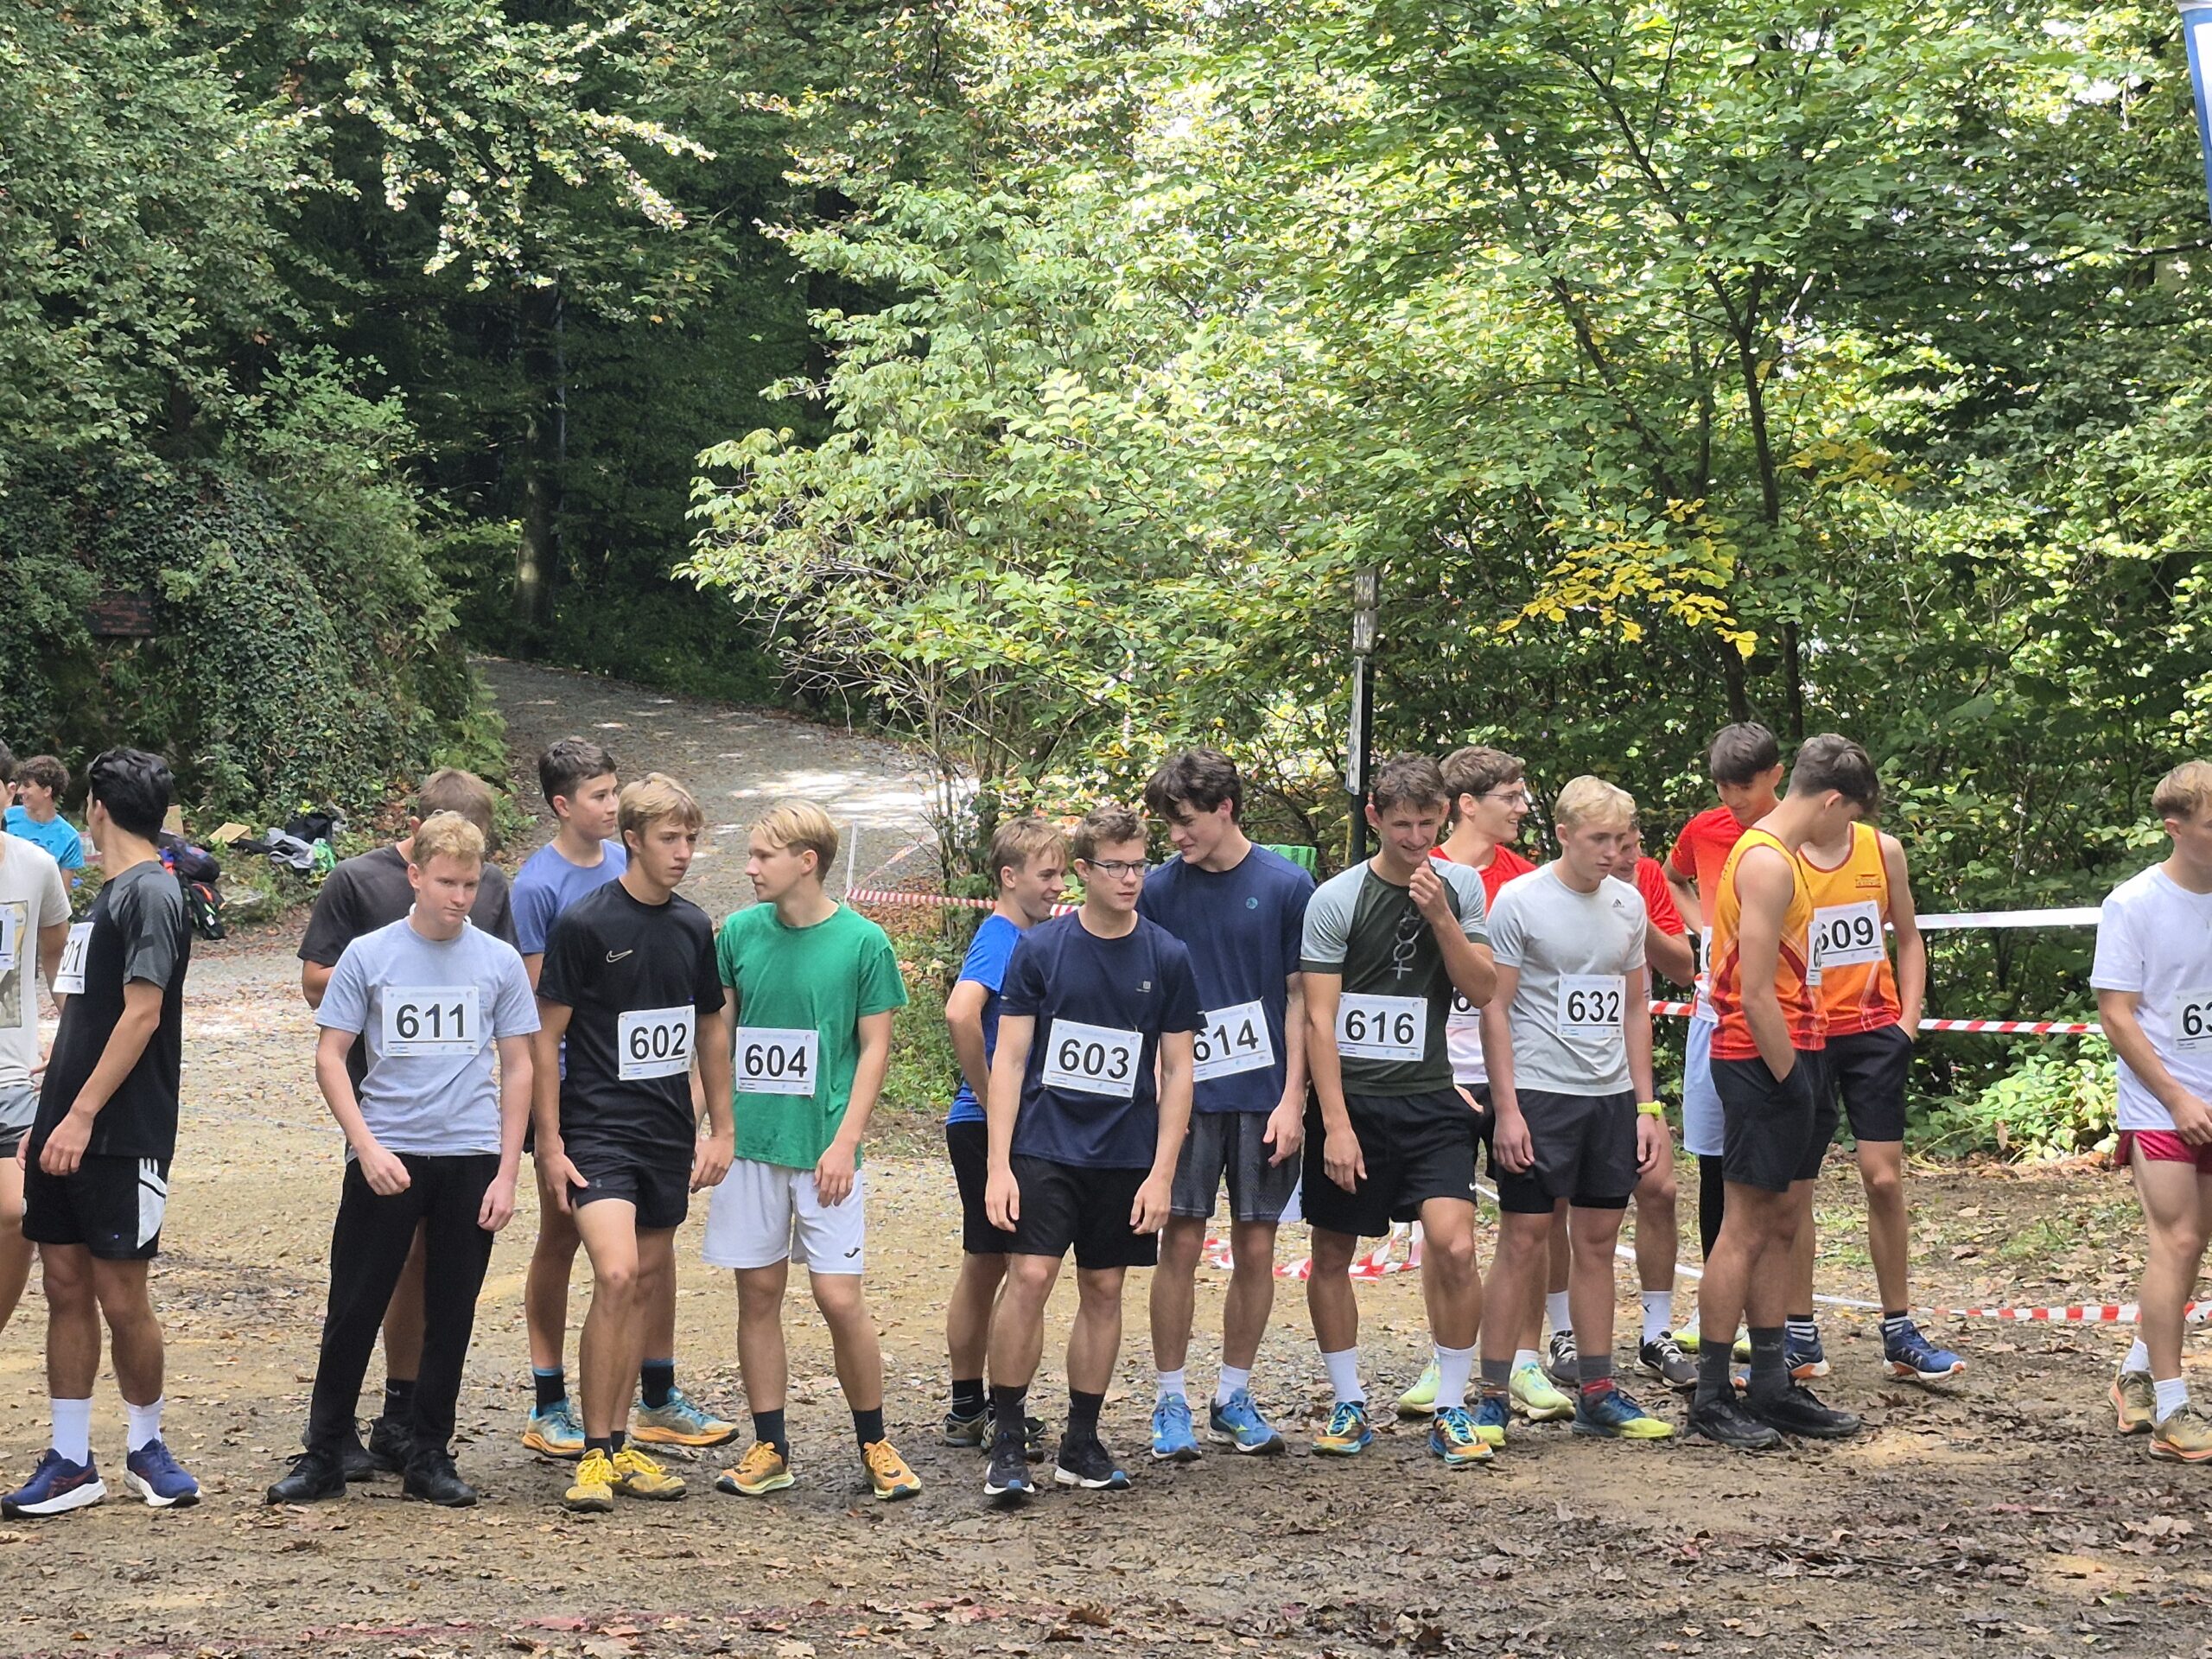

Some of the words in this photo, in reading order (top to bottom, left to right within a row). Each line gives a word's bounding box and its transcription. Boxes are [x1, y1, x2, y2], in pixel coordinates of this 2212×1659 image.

[62, 938, 83, 972] 01
[396, 1003, 464, 1039] 611
[1567, 990, 1619, 1022] 632
[630, 1022, 687, 1059] 602
[1193, 1018, 1259, 1062] 614
[1345, 1009, 1414, 1045] 616
[745, 1044, 807, 1077] 604
[1058, 1039, 1129, 1079] 603
